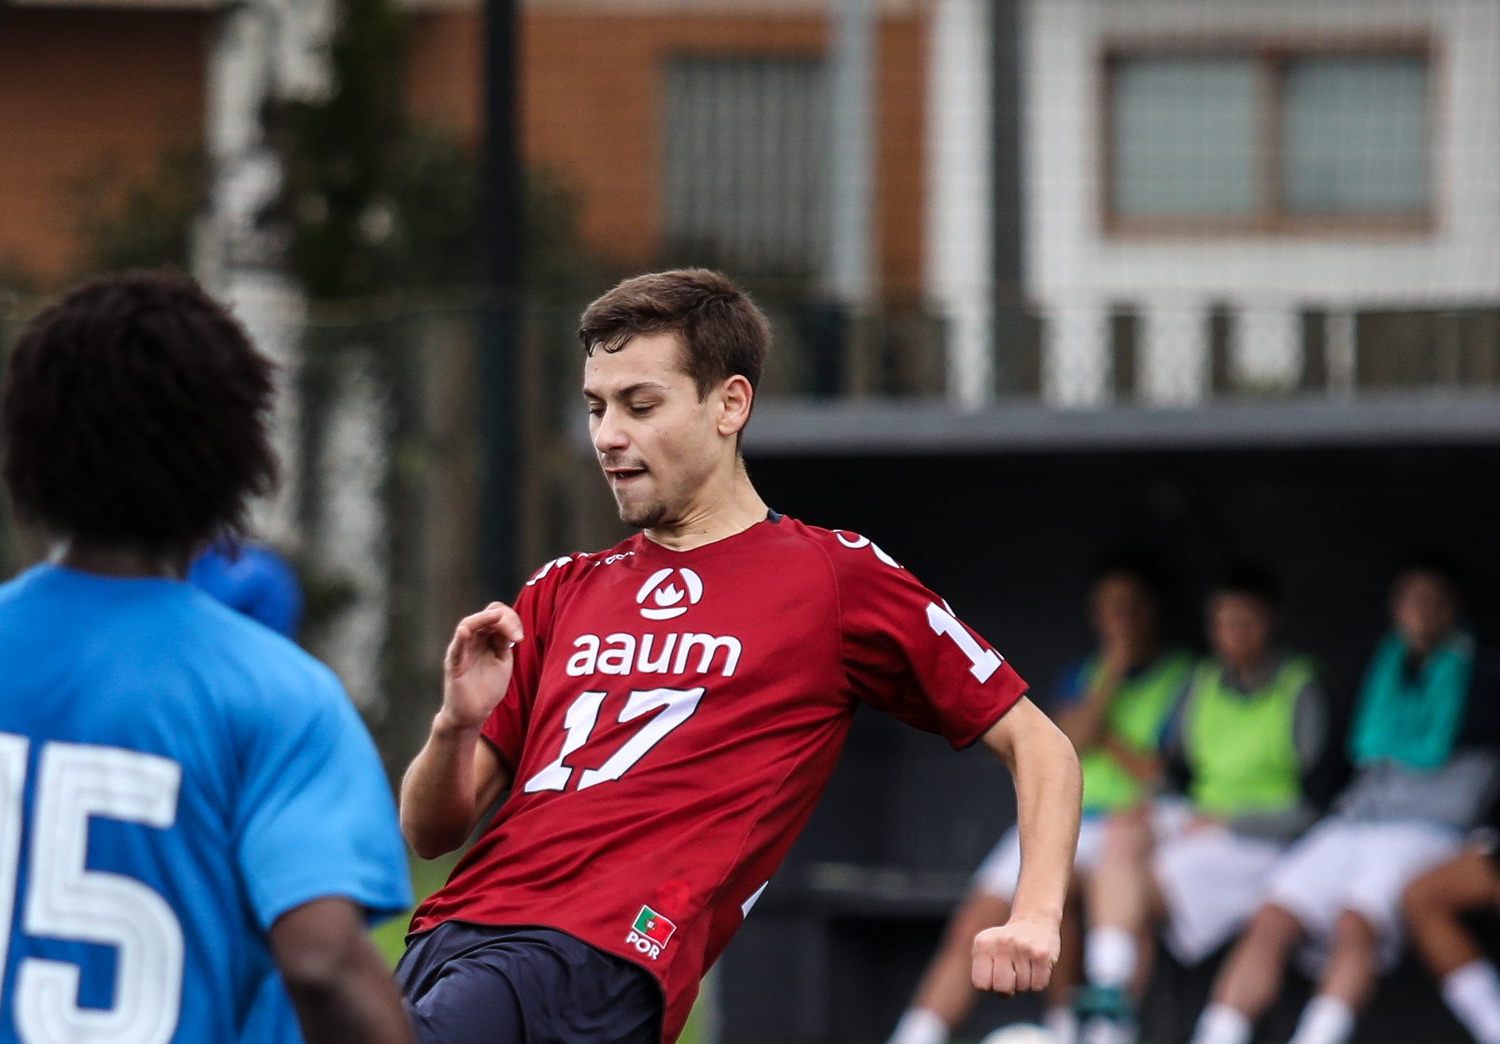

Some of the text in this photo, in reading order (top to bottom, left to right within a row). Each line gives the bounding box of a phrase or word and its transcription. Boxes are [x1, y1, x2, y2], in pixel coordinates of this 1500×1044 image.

[565, 633, 742, 677] aaum
[925, 599, 1005, 684] 1
[524, 687, 706, 793] 17
[626, 931, 660, 960] POR
